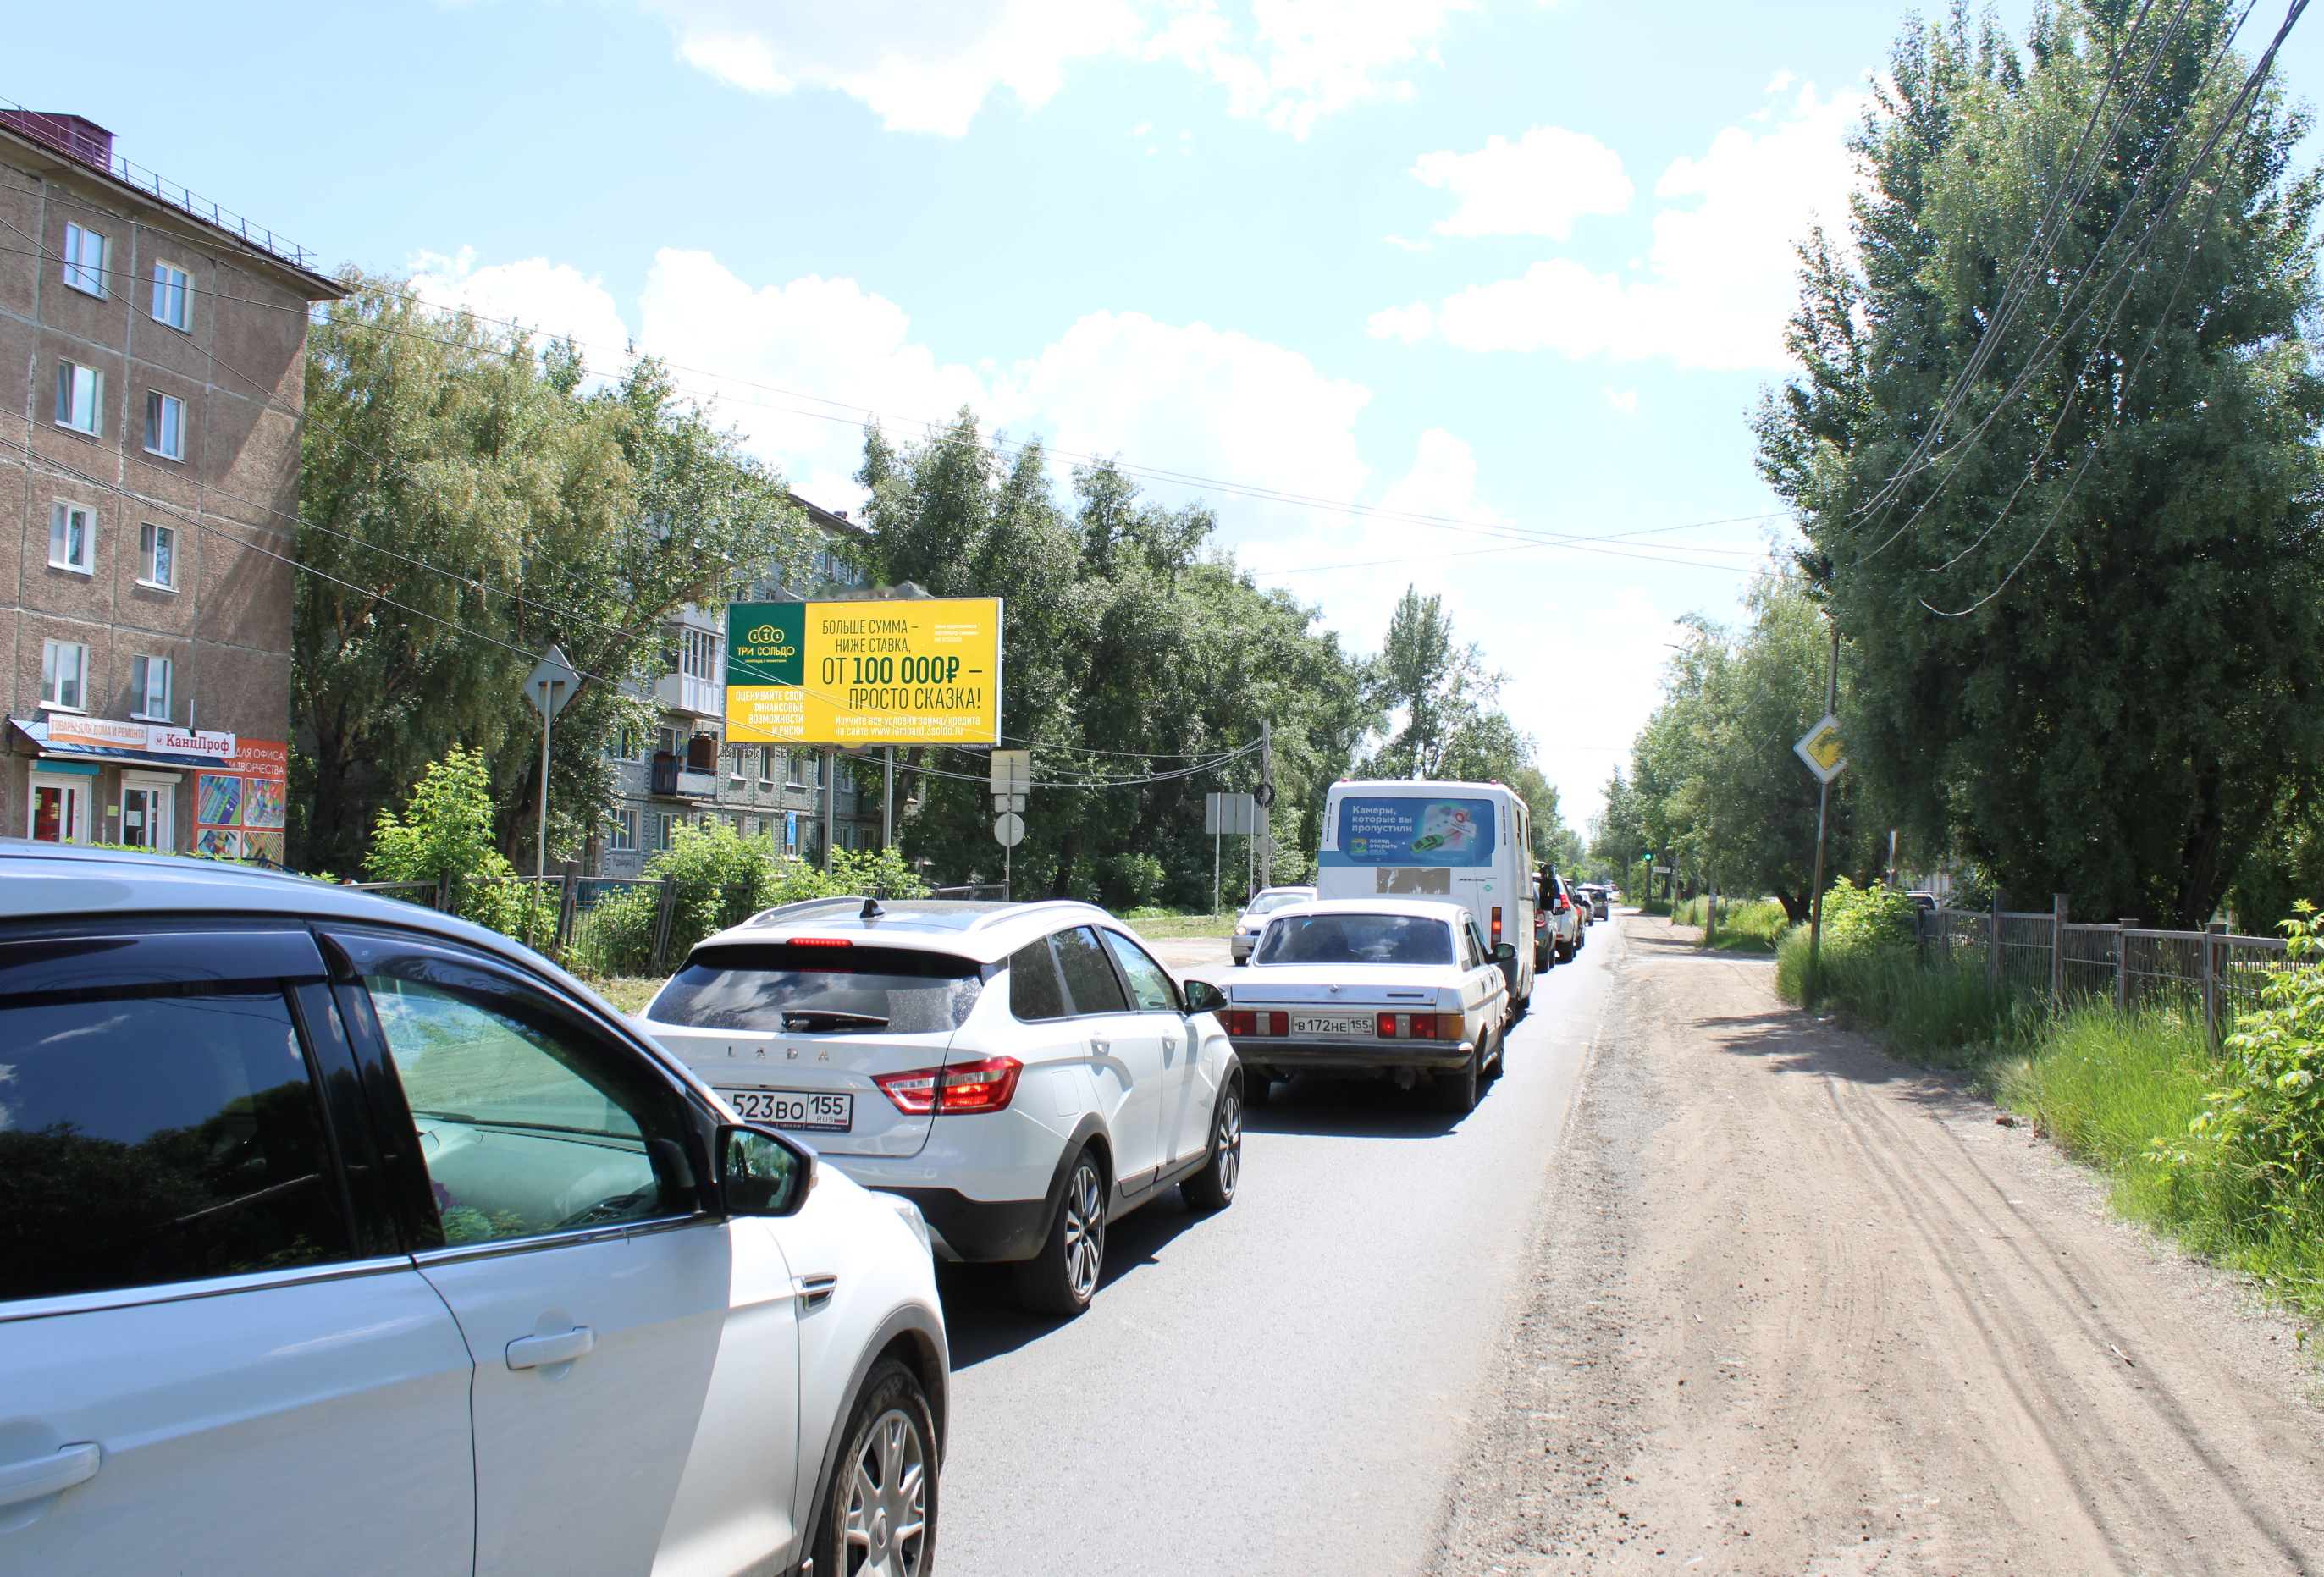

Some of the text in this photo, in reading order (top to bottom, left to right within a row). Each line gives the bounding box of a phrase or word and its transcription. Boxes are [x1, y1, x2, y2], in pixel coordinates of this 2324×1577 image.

[822, 620, 865, 634] БОЛЬШЕ
[869, 619, 908, 634] СУММА
[737, 646, 795, 658] ТРИ СОЛЬДО
[836, 637, 911, 654] НИЖЕ СТАВКА,
[822, 657, 847, 685] ОТ
[853, 656, 893, 685] 100
[736, 689, 804, 702] ОЦЕНИВАЙТЕ СВОИ
[849, 687, 980, 709] ПРОСТО СКАЗКА!
[753, 702, 803, 713] ФИНАНСОВЫЕ
[748, 714, 803, 724] ВОЗМОЖНОСТИ
[836, 714, 980, 727] Изучите все условия займа/кредита
[51, 719, 145, 739] ТОВАРЫ ДЛЯ ДОМА И РЕМОНТА
[772, 725, 803, 736] И РИСКИ
[847, 726, 869, 736] сайте
[870, 725, 963, 736] www.lombard.3soldo.ru
[166, 733, 229, 755] КанцПроф
[235, 747, 286, 762] ДЛЯ ОФИСА,
[237, 761, 284, 775] ТВОРЧЕСТВА
[1352, 805, 1397, 816] Камеры,
[1352, 816, 1396, 824] которые
[1352, 824, 1412, 834] пропустили
[1350, 1019, 1369, 1029] 155
[728, 1045, 830, 1061] LADA
[722, 1094, 844, 1120] 523ВО 155
[816, 1115, 834, 1123] RUS
